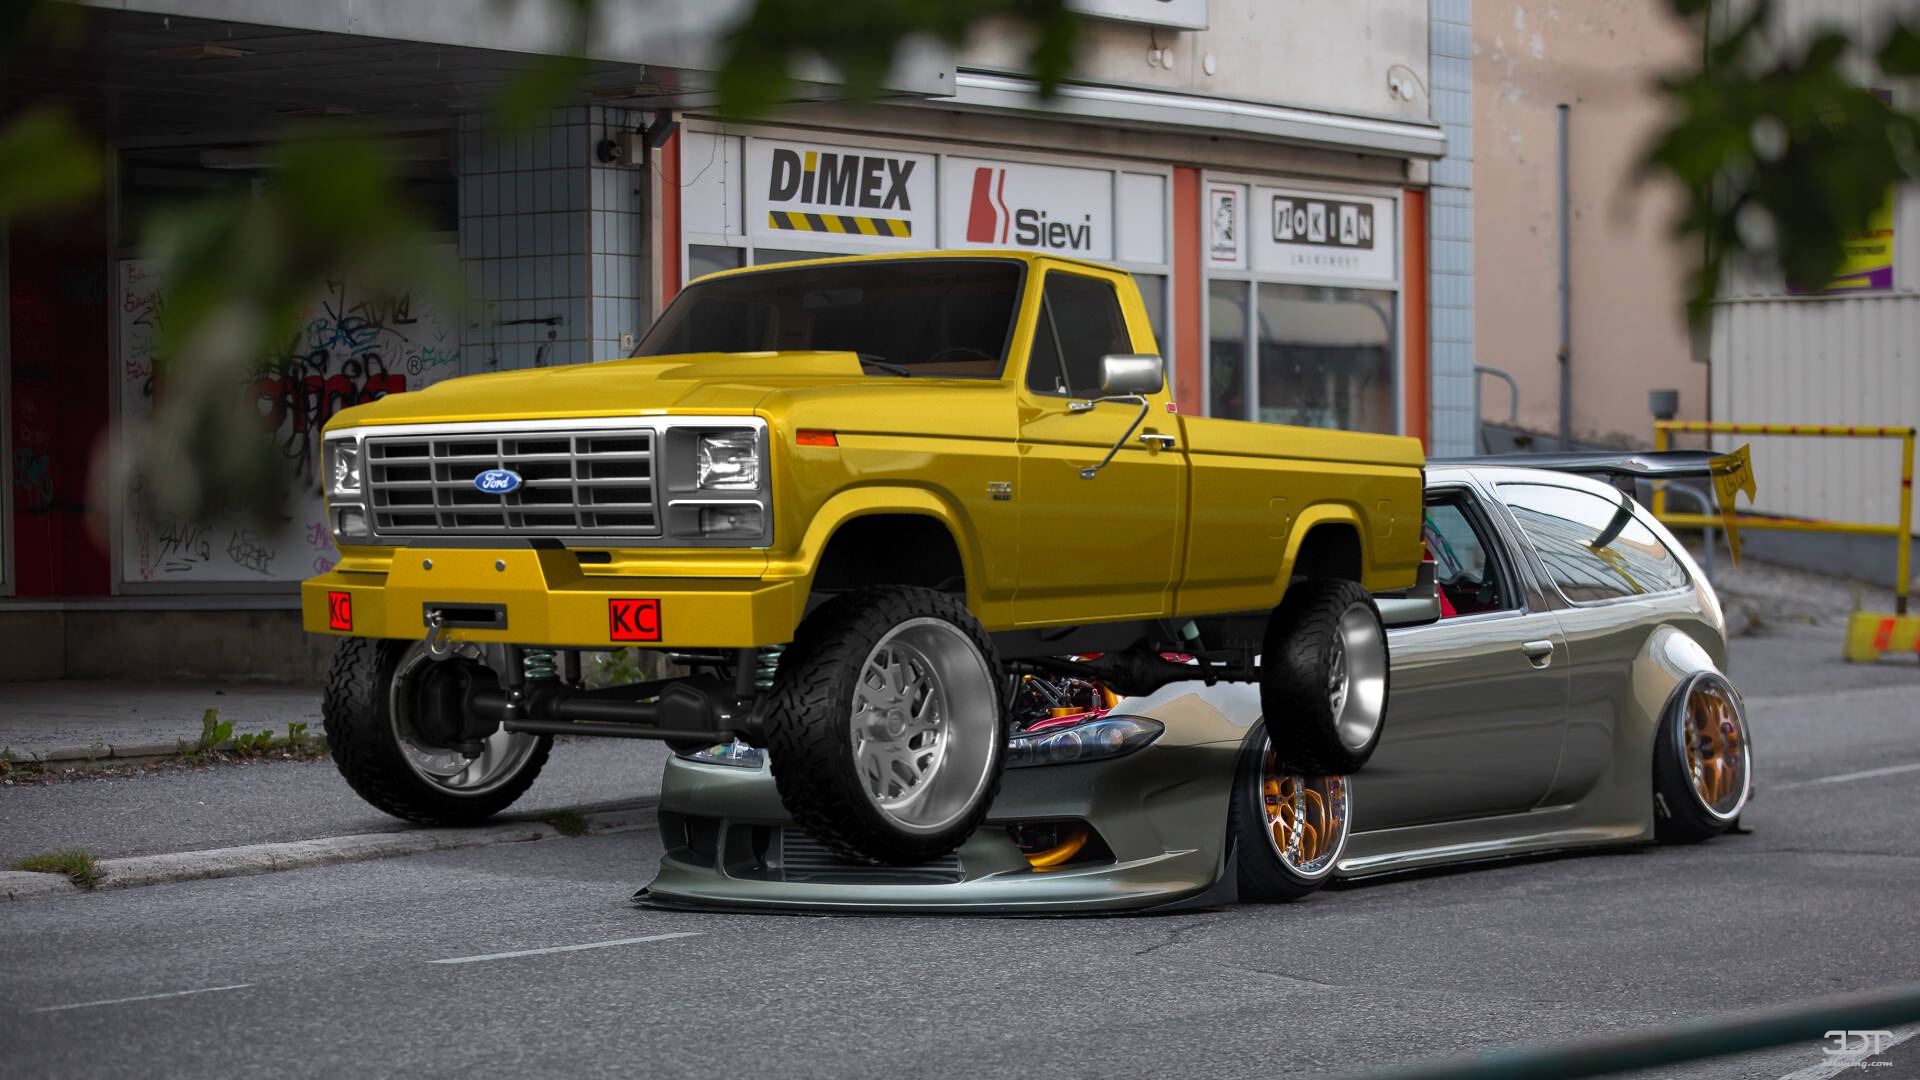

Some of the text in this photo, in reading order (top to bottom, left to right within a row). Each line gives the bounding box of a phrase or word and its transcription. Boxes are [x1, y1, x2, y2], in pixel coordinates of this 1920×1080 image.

[769, 148, 916, 211] DIMEX
[1015, 209, 1092, 250] Sievi
[482, 473, 510, 488] Ford
[330, 595, 349, 626] KC
[612, 603, 656, 634] KC
